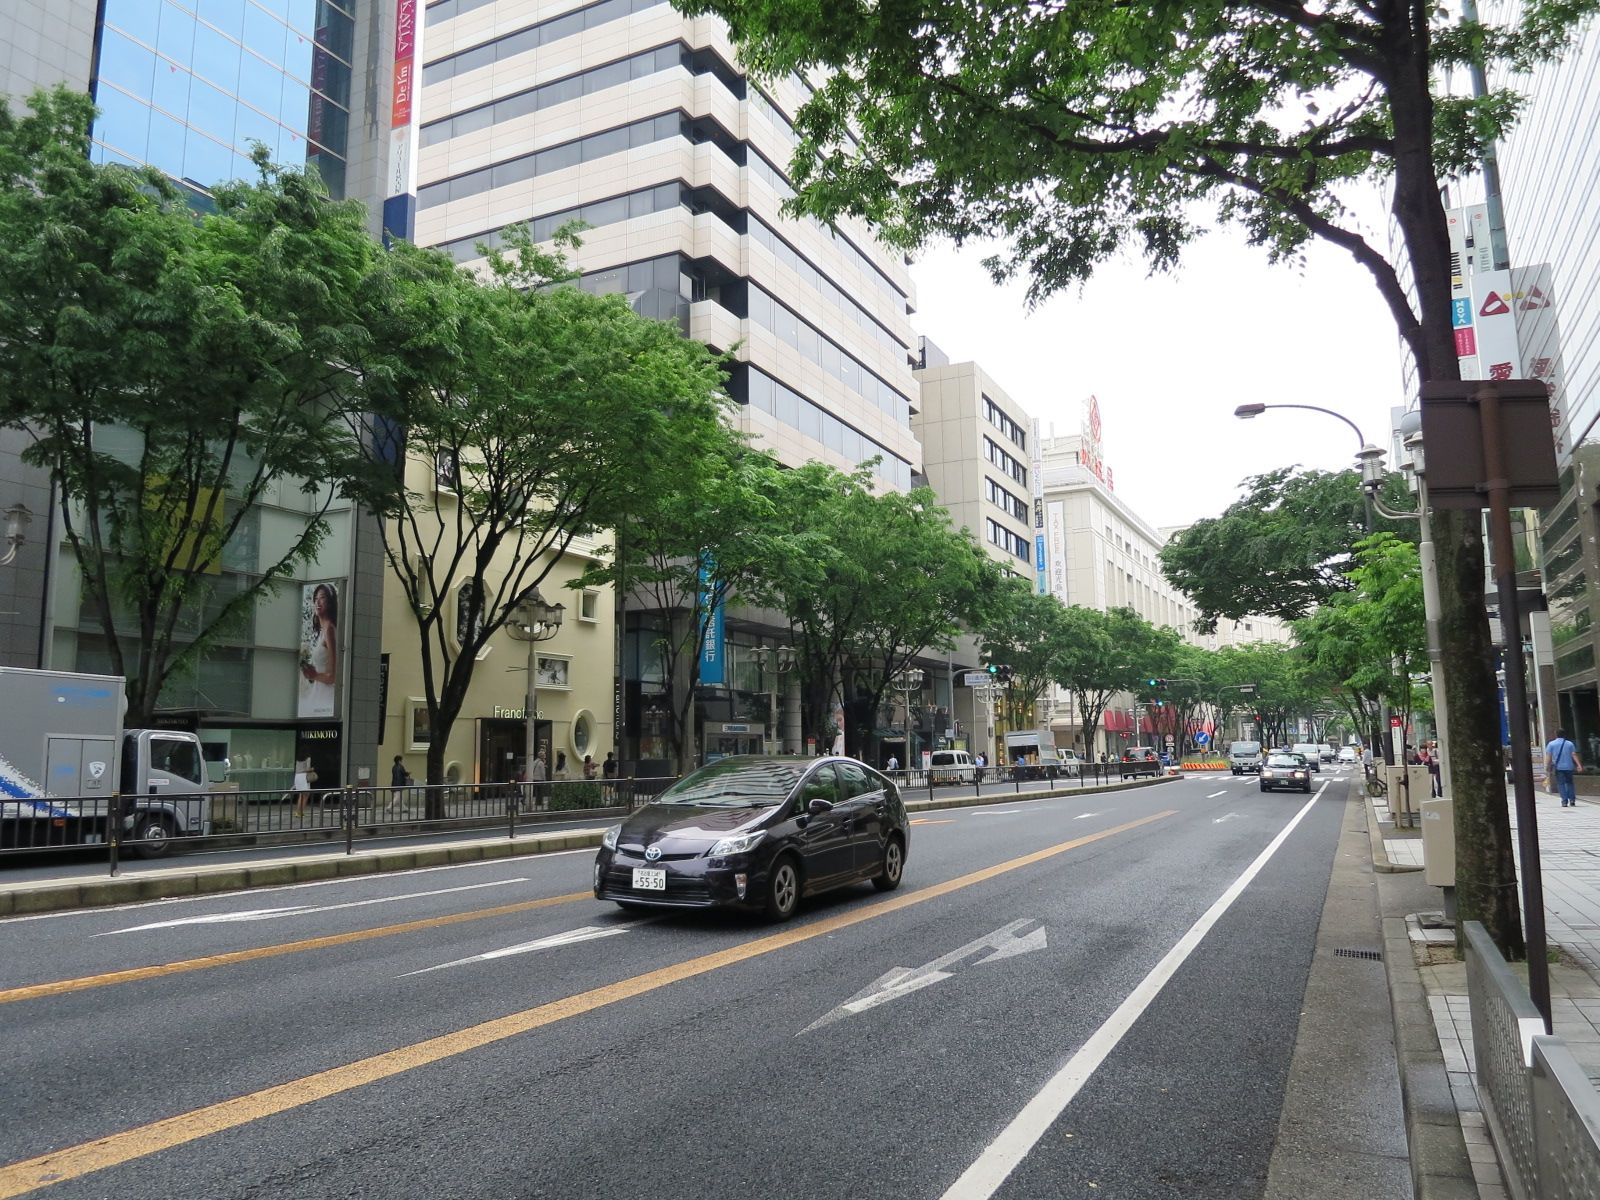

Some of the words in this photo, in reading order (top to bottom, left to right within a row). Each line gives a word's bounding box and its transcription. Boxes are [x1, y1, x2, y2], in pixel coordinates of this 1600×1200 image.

[1455, 300, 1467, 325] NOVA
[494, 705, 544, 720] Francfc
[301, 730, 338, 739] MIKIMOTO
